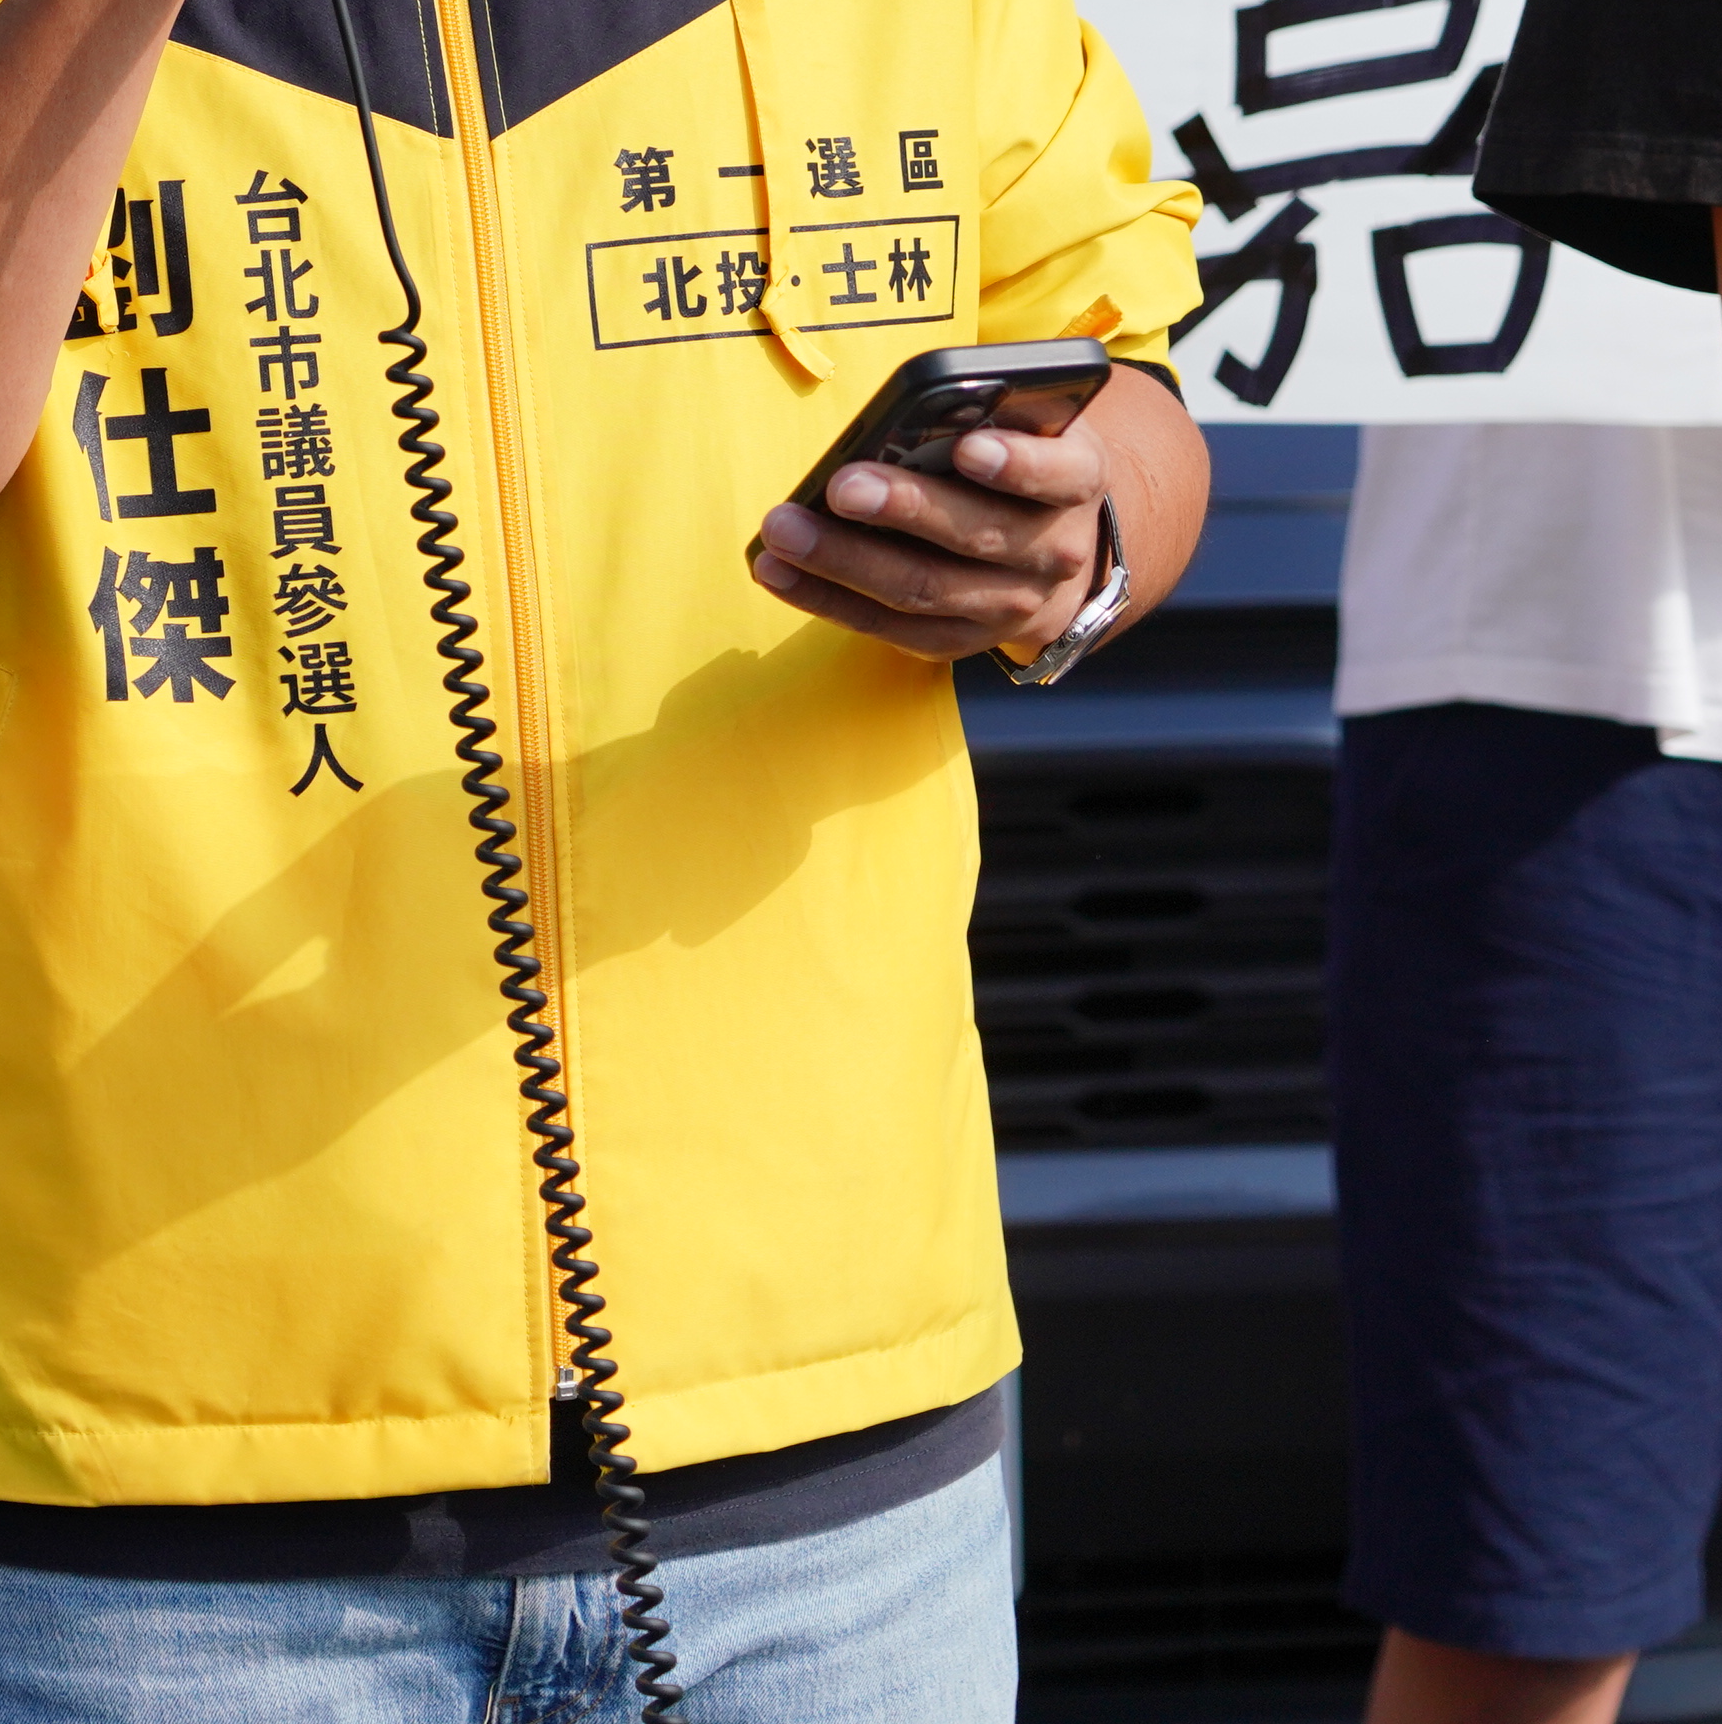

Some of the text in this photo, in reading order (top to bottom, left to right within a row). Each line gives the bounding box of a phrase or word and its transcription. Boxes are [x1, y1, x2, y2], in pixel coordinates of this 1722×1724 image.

[613, 129, 944, 213] 第一選區
[235, 169, 365, 797] 台北市議員參選人
